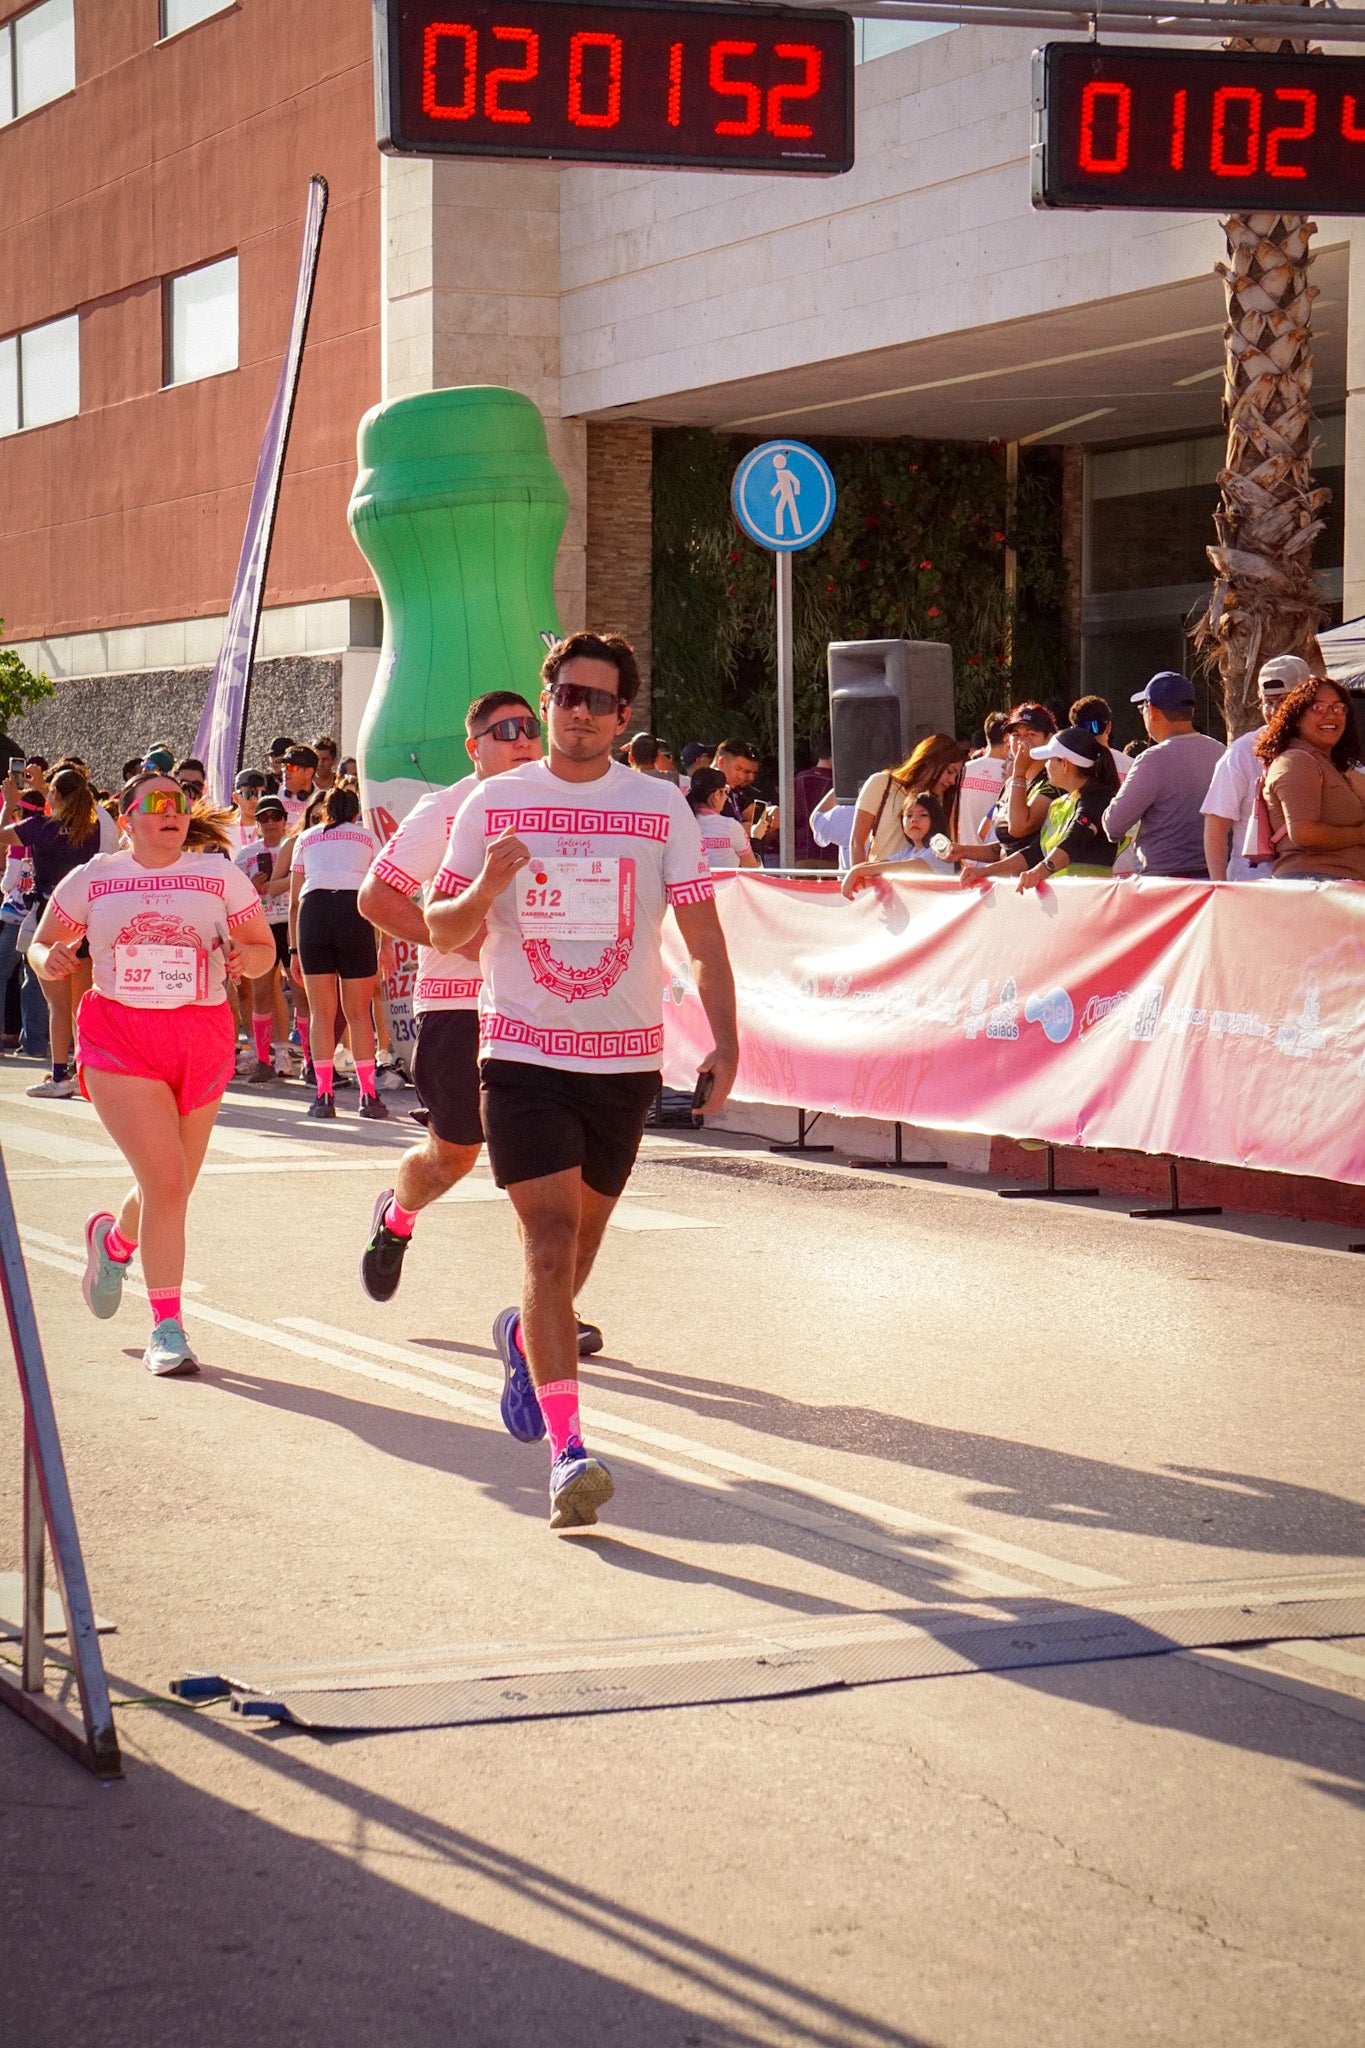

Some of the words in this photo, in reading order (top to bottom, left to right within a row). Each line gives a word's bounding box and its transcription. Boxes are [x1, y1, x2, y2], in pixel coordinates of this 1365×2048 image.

[525, 889, 562, 907] 512
[123, 968, 152, 982] 537
[987, 1024, 1018, 1038] salads
